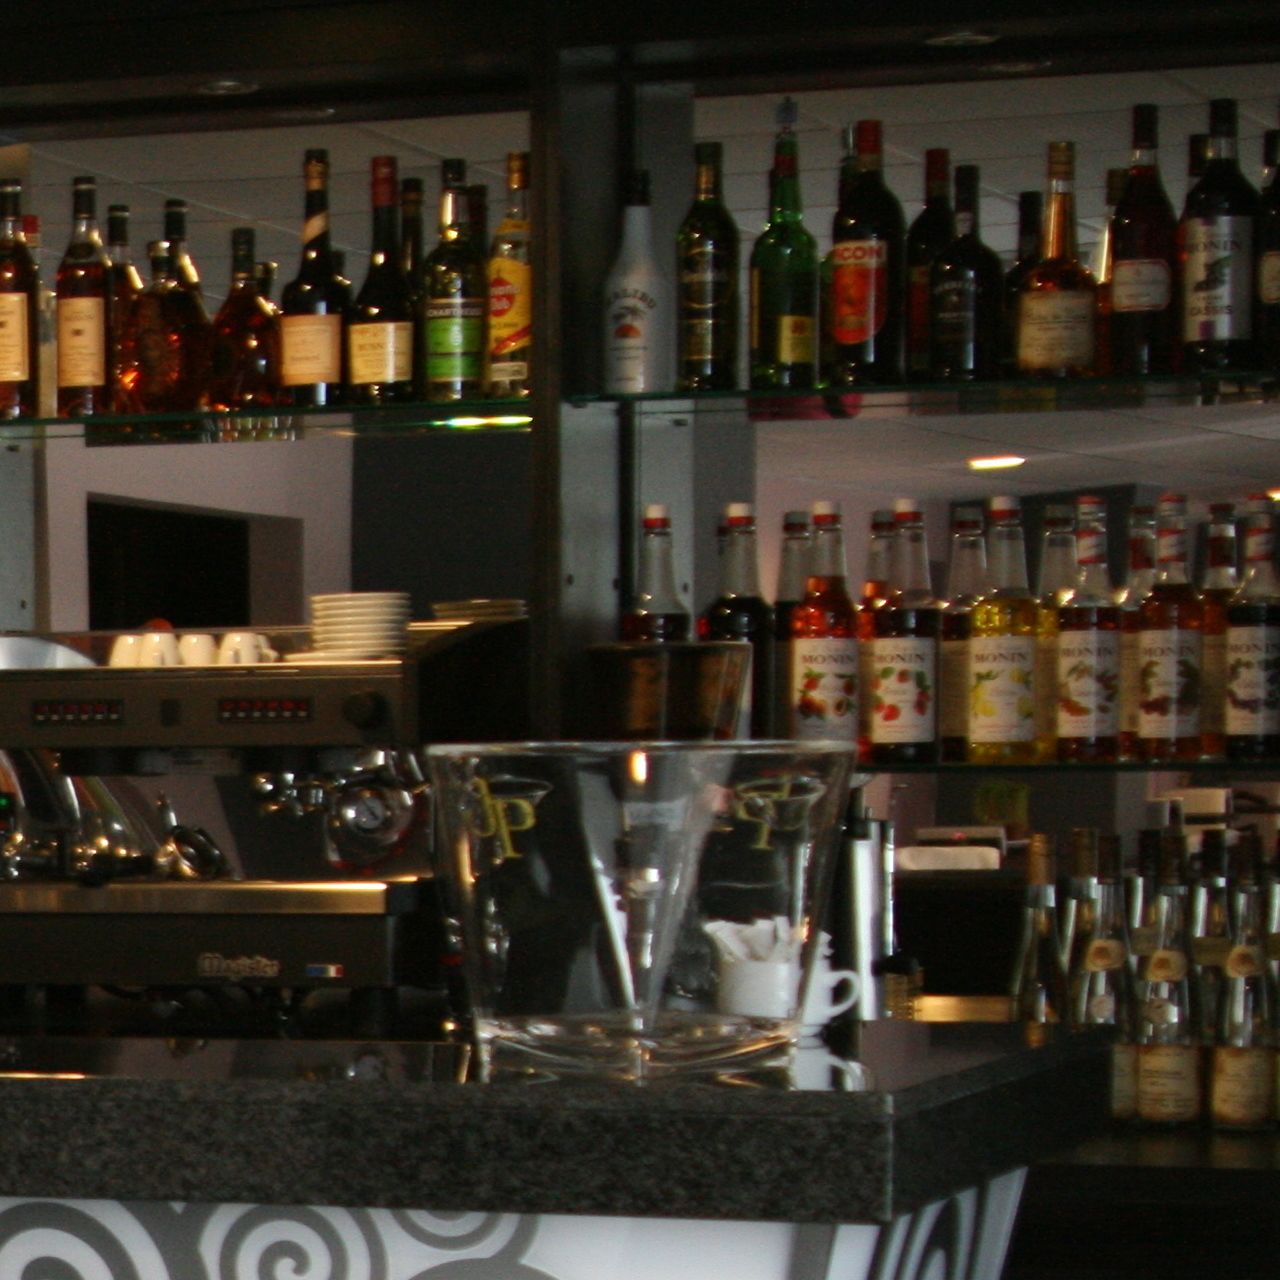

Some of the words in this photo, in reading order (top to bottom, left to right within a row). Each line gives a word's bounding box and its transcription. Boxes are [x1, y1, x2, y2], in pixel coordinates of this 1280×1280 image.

[802, 654, 856, 665] MONIN
[874, 653, 926, 664] MONIN
[975, 652, 1027, 663] MONIN
